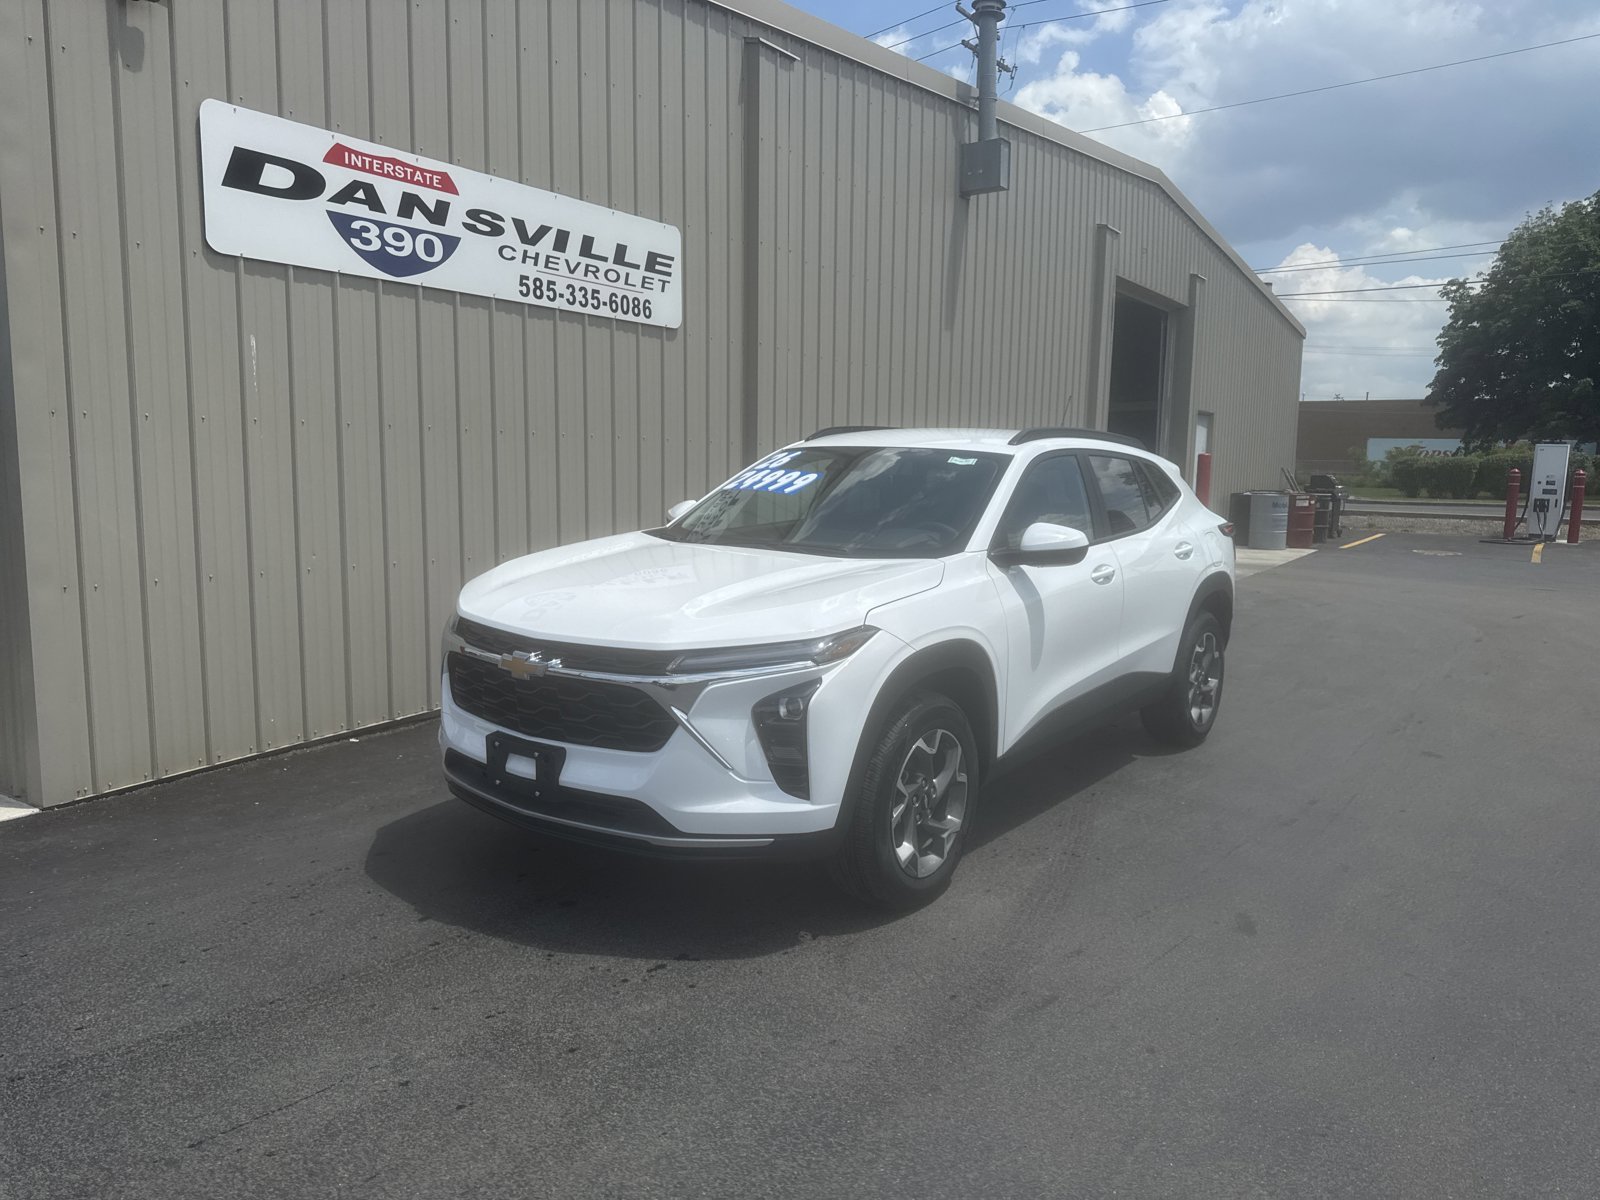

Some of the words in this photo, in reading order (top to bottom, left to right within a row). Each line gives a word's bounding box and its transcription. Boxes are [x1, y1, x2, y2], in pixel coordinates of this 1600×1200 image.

[344, 151, 442, 188] INTERSTATE
[221, 146, 675, 277] DANSVILLE
[350, 220, 444, 263] 390
[498, 245, 670, 293] CHEVROLET
[518, 274, 652, 319] 585-335-6086
